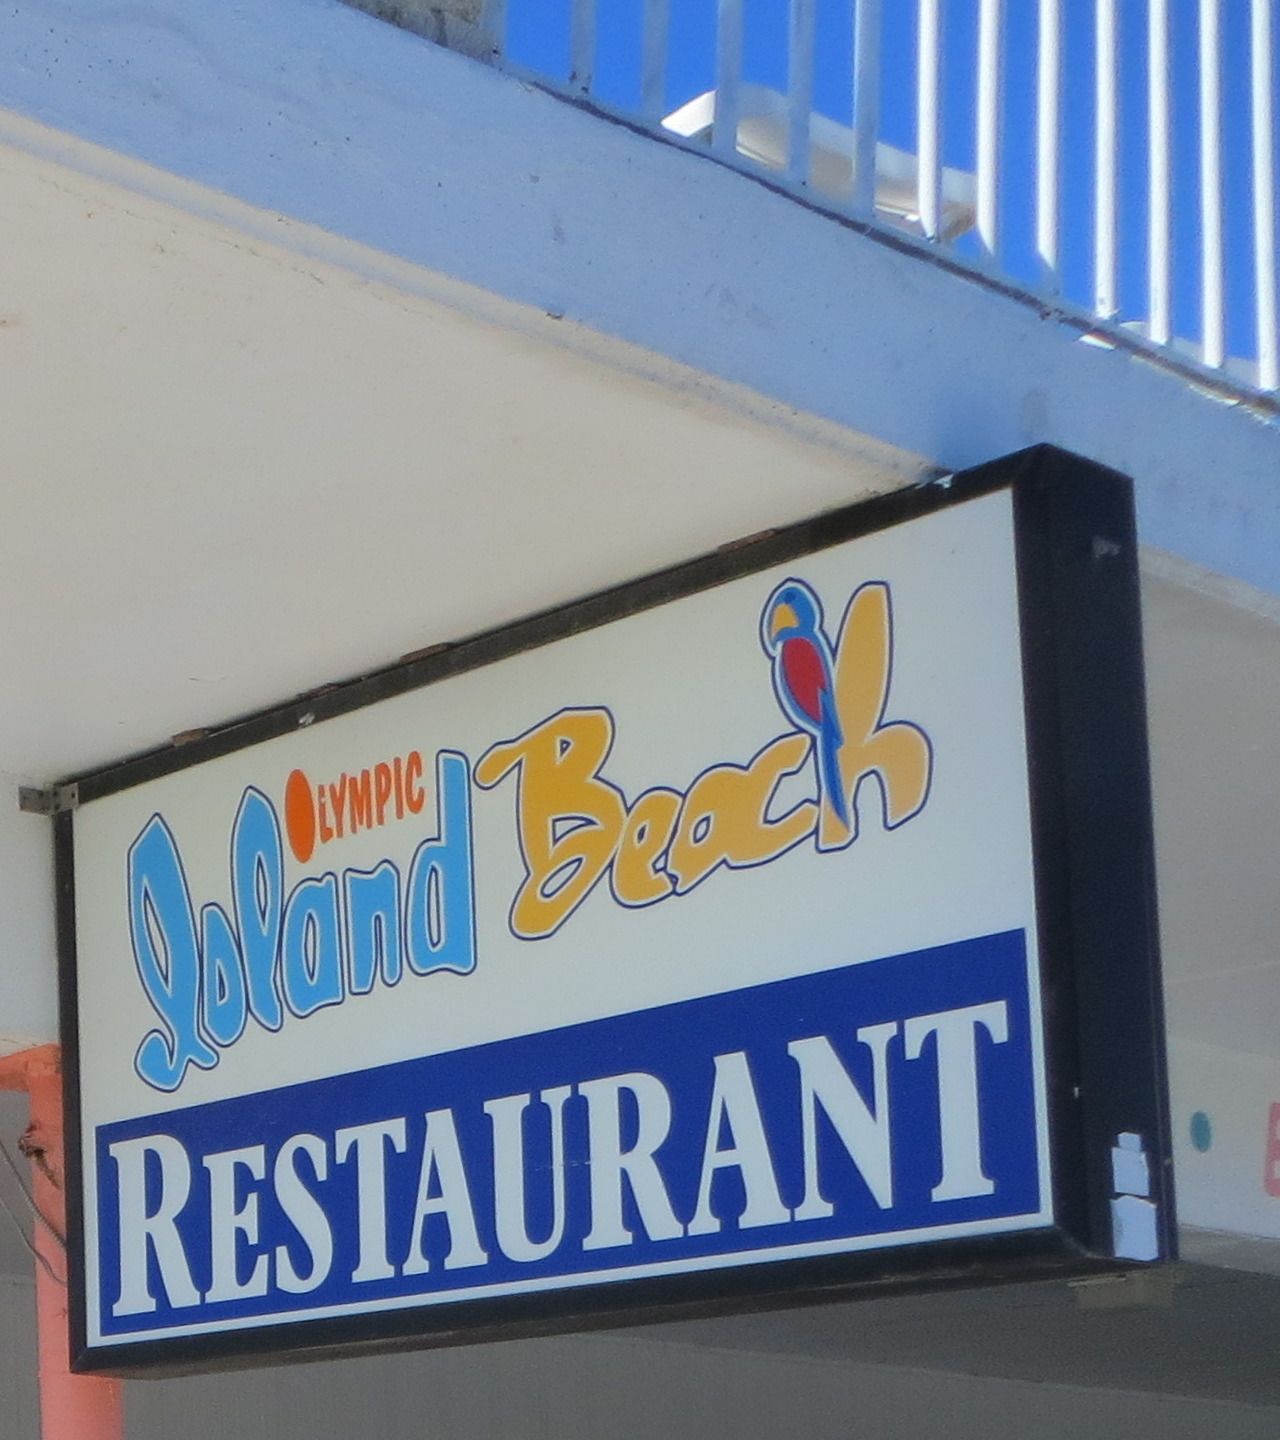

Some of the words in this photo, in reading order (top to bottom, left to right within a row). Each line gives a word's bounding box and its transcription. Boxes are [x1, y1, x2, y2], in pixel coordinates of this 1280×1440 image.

[126, 750, 478, 1092] Island
[474, 581, 933, 940] Beach
[286, 750, 425, 863] OLYMPIC
[110, 999, 1009, 1319] RESTAURANT
